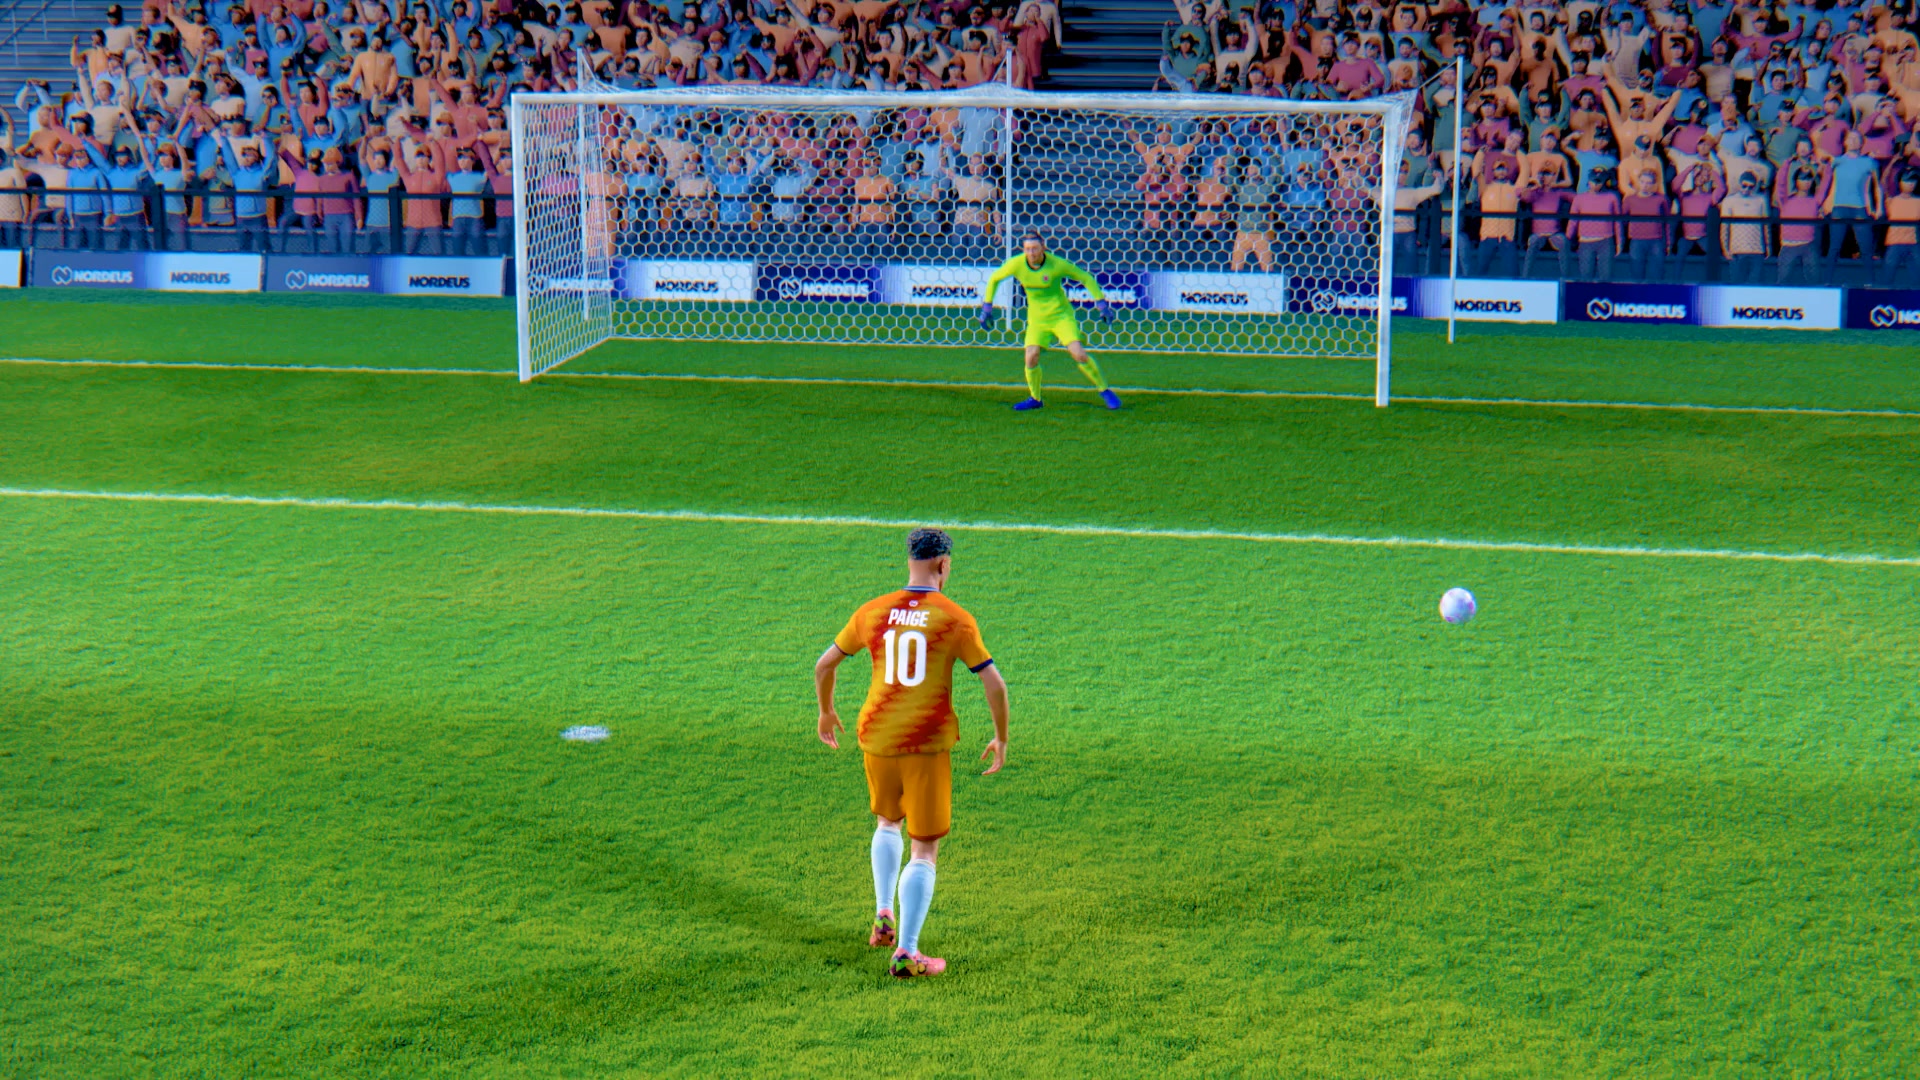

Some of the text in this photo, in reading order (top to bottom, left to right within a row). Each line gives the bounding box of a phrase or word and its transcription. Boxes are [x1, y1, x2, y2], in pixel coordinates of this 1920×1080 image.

[74, 270, 133, 283] NORDEUS
[170, 272, 230, 284] NORDEUS
[308, 274, 370, 288] NORDEUS
[409, 276, 470, 288] NORDEUS
[1454, 299, 1523, 313] NORDEUS
[1614, 303, 1686, 318] NORDEUS
[1732, 306, 1804, 320] NORDEUS
[888, 608, 930, 627] PAIGE
[883, 629, 927, 687] 10
